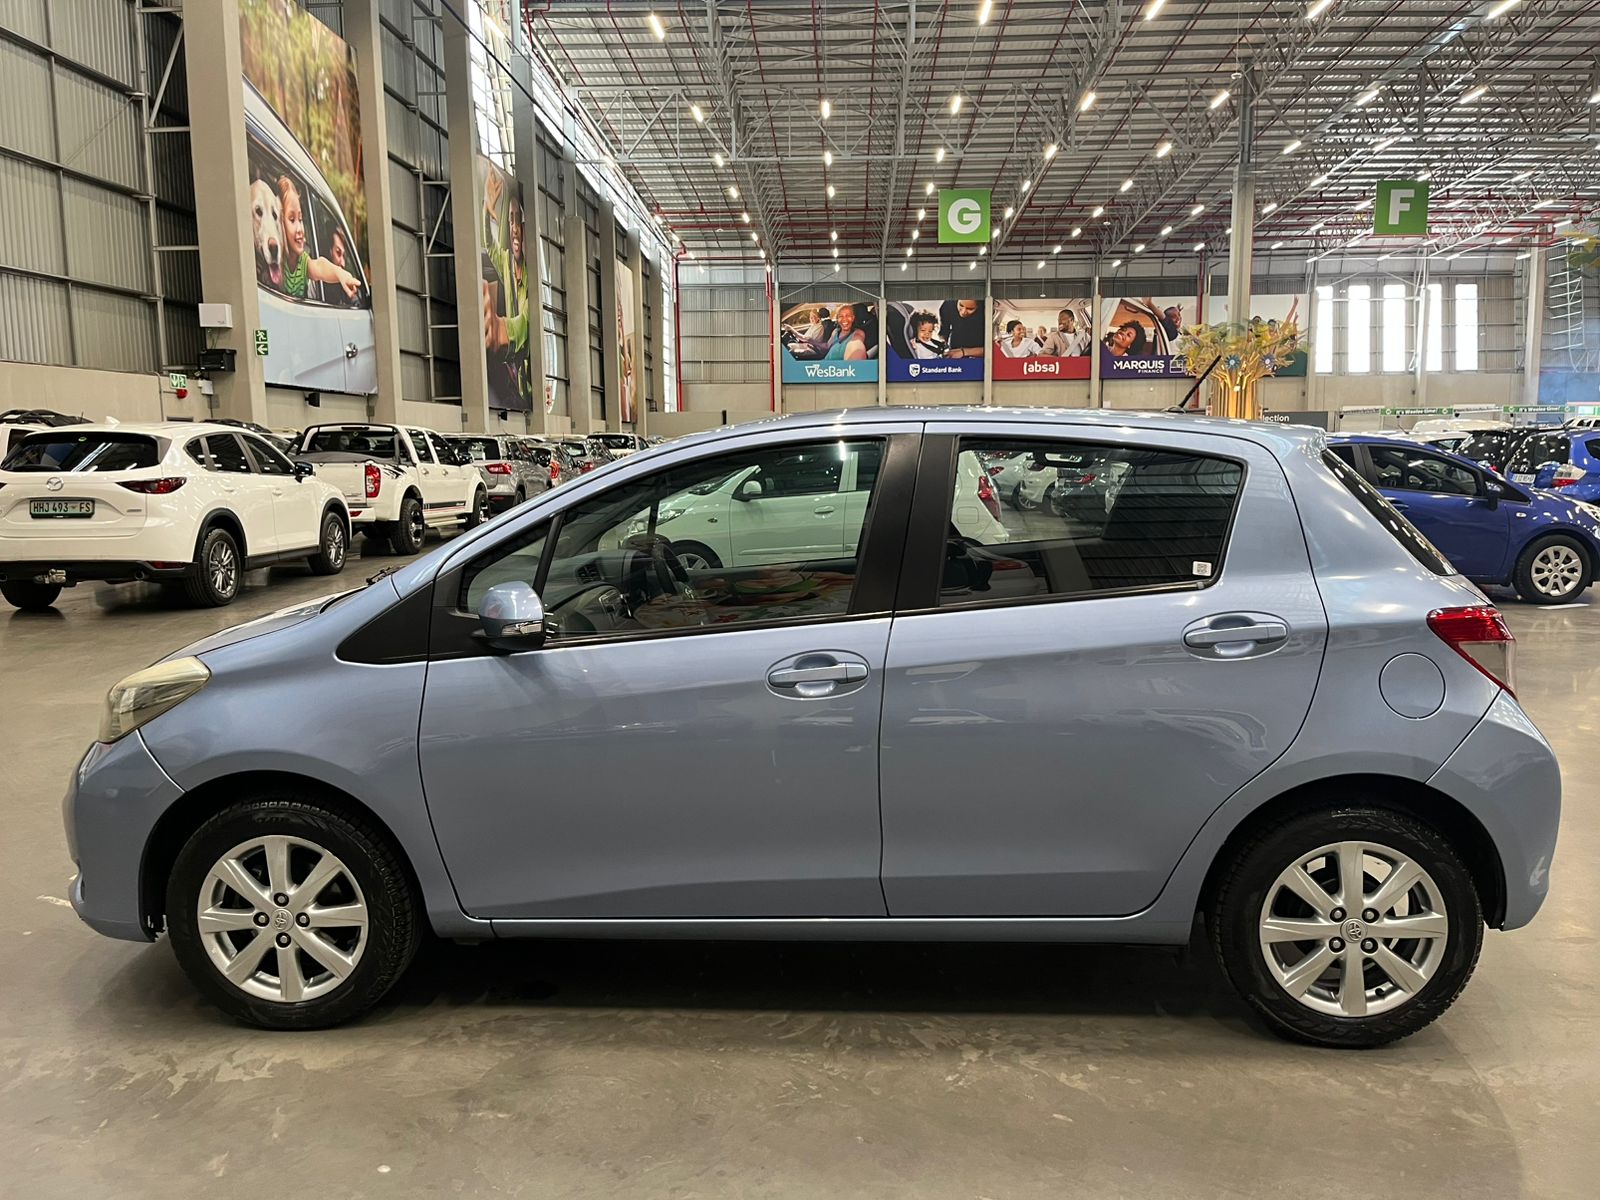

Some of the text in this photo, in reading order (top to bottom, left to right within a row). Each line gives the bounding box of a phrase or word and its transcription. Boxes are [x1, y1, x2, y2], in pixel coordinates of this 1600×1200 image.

[1388, 189, 1415, 225] F
[947, 198, 981, 234] G
[804, 363, 856, 377] WesBank
[921, 366, 947, 374] Standard
[1023, 361, 1059, 375] (absa)
[1113, 360, 1165, 370] MARQUIS
[33, 502, 91, 513] HHJ 493 FS
